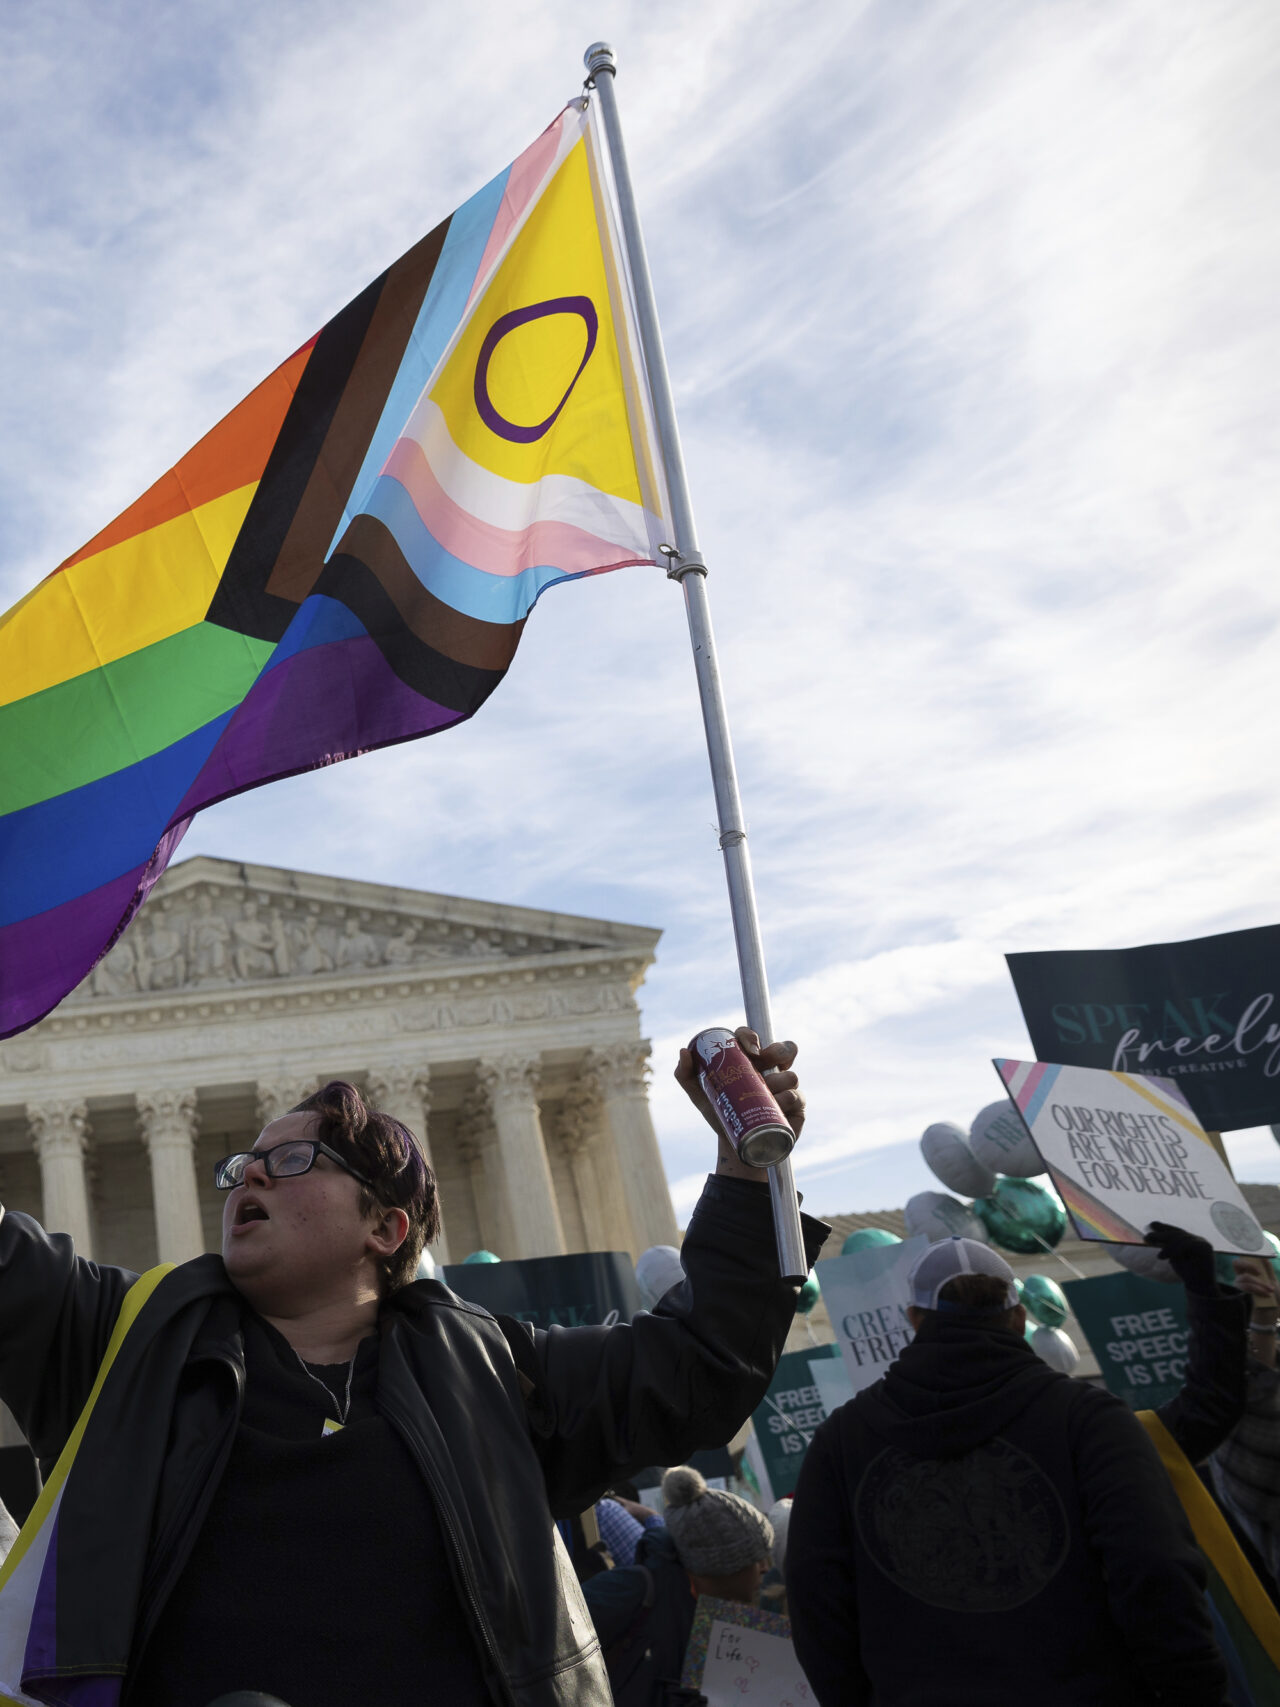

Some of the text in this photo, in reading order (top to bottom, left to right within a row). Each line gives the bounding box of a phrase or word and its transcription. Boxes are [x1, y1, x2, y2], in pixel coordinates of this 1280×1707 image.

[1051, 991, 1236, 1045] SPEAK
[1167, 1059, 1247, 1076] CREATIVE
[1051, 1104, 1182, 1145] OUR RIGHTS
[1067, 1132, 1188, 1170] ARE NOT UP
[1076, 1161, 1215, 1200] FOR DEBATE
[842, 1303, 915, 1341] CREA
[1110, 1308, 1179, 1337] FREE
[1106, 1331, 1190, 1362] SPEEC
[1123, 1359, 1189, 1385] IS FO
[780, 1435, 803, 1454] IS
